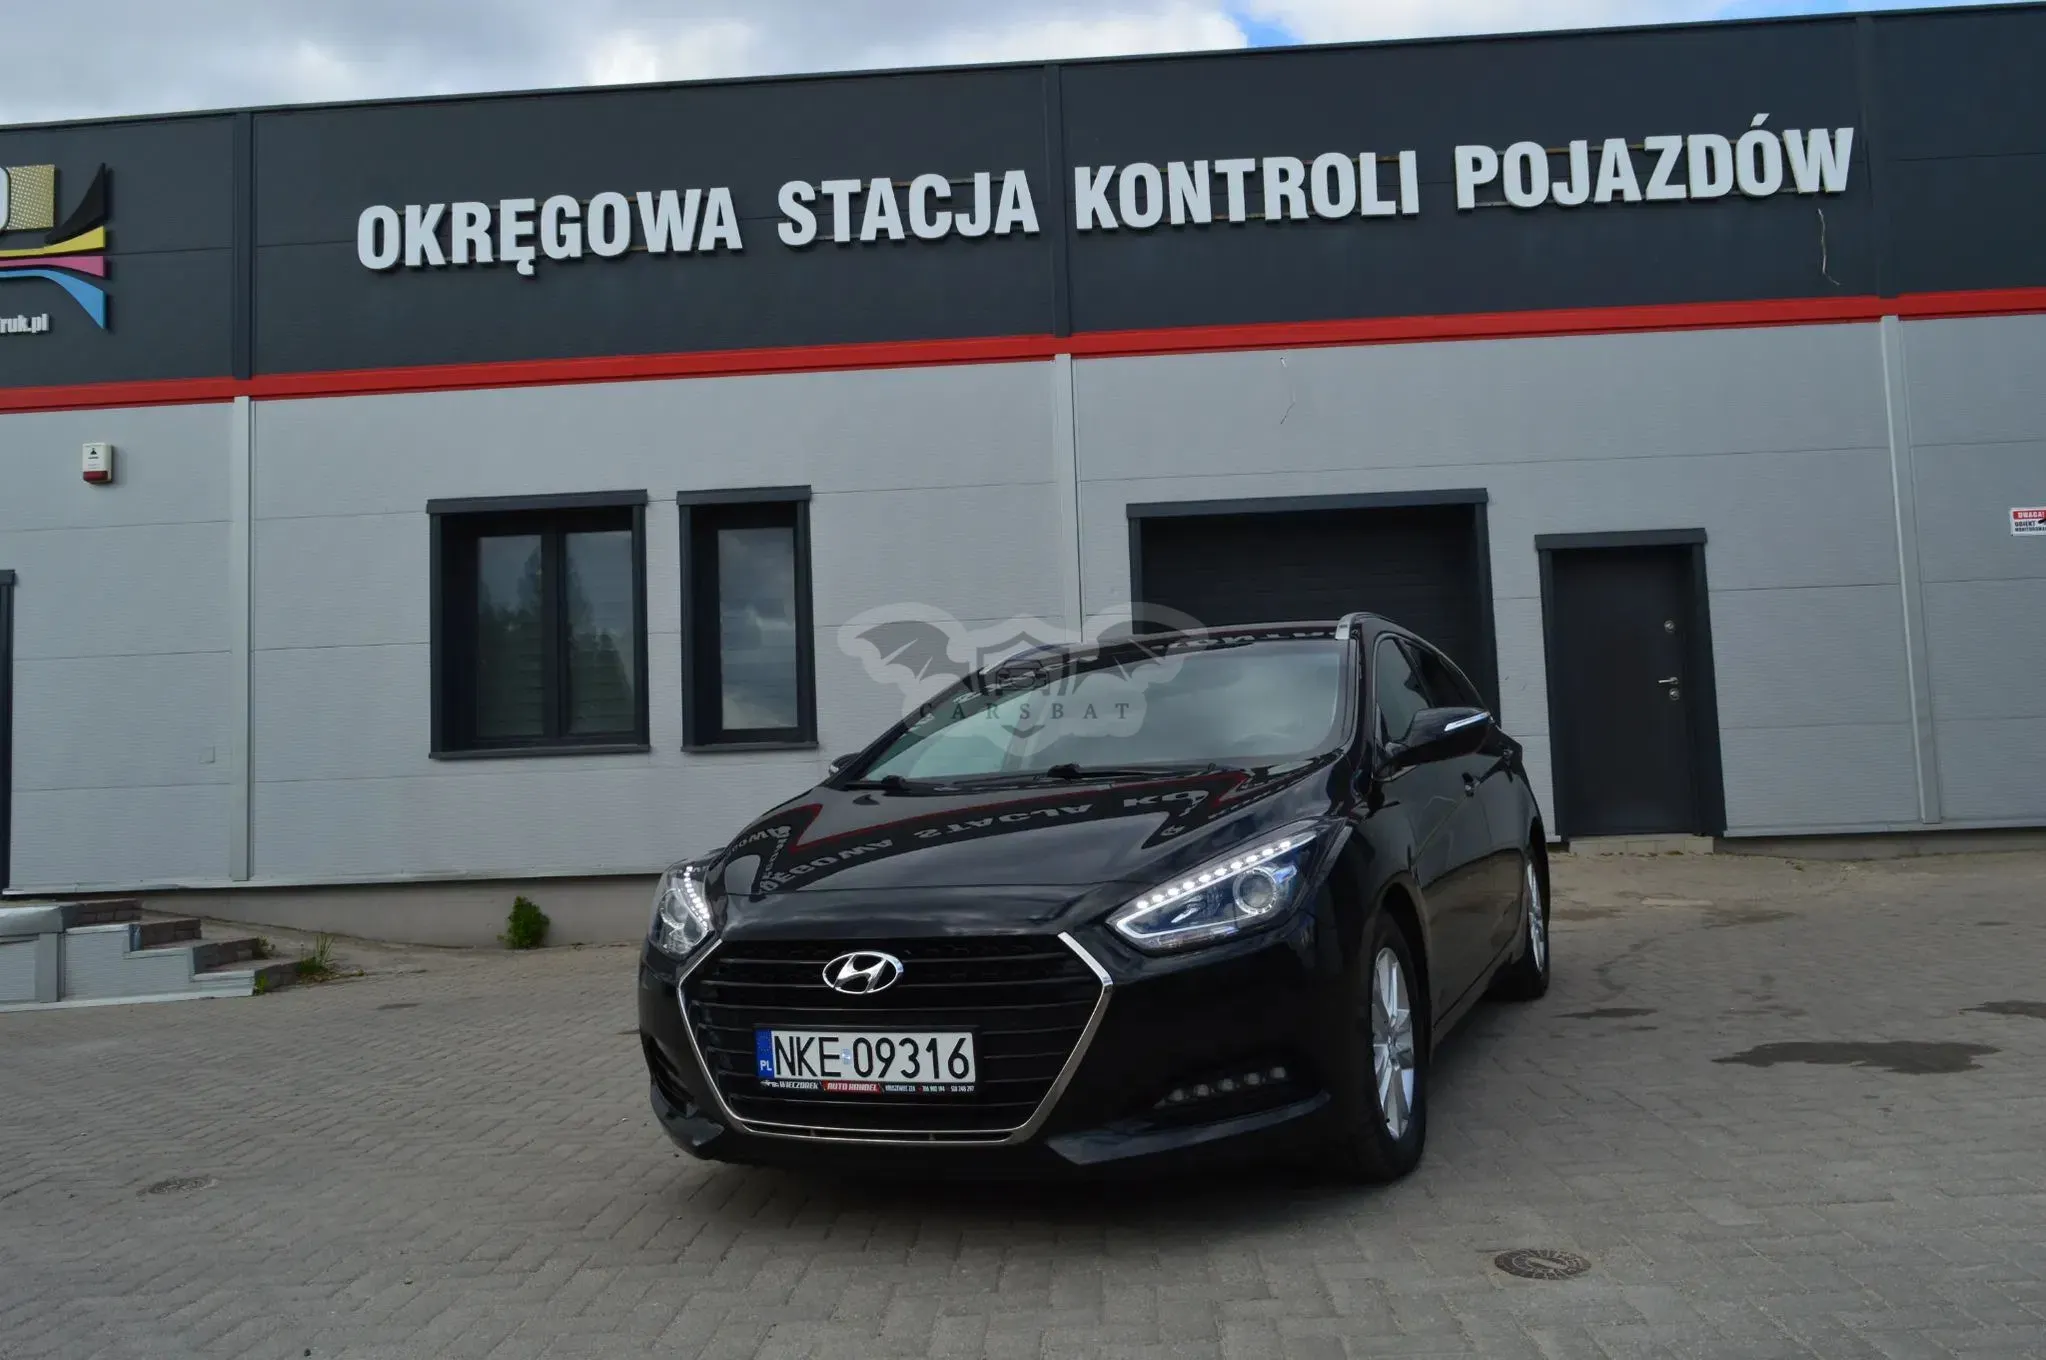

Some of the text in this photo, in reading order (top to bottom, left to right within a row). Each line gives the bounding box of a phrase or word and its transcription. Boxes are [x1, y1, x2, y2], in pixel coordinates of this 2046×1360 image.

[356, 113, 1854, 275] OKRĘGOWA STACJA KONTROLI POJAZDÓW
[773, 1036, 969, 1079] NKE 09316
[760, 1060, 772, 1071] PL
[780, 1081, 818, 1090] WIECZOREK
[827, 1083, 848, 1091] AUTO
